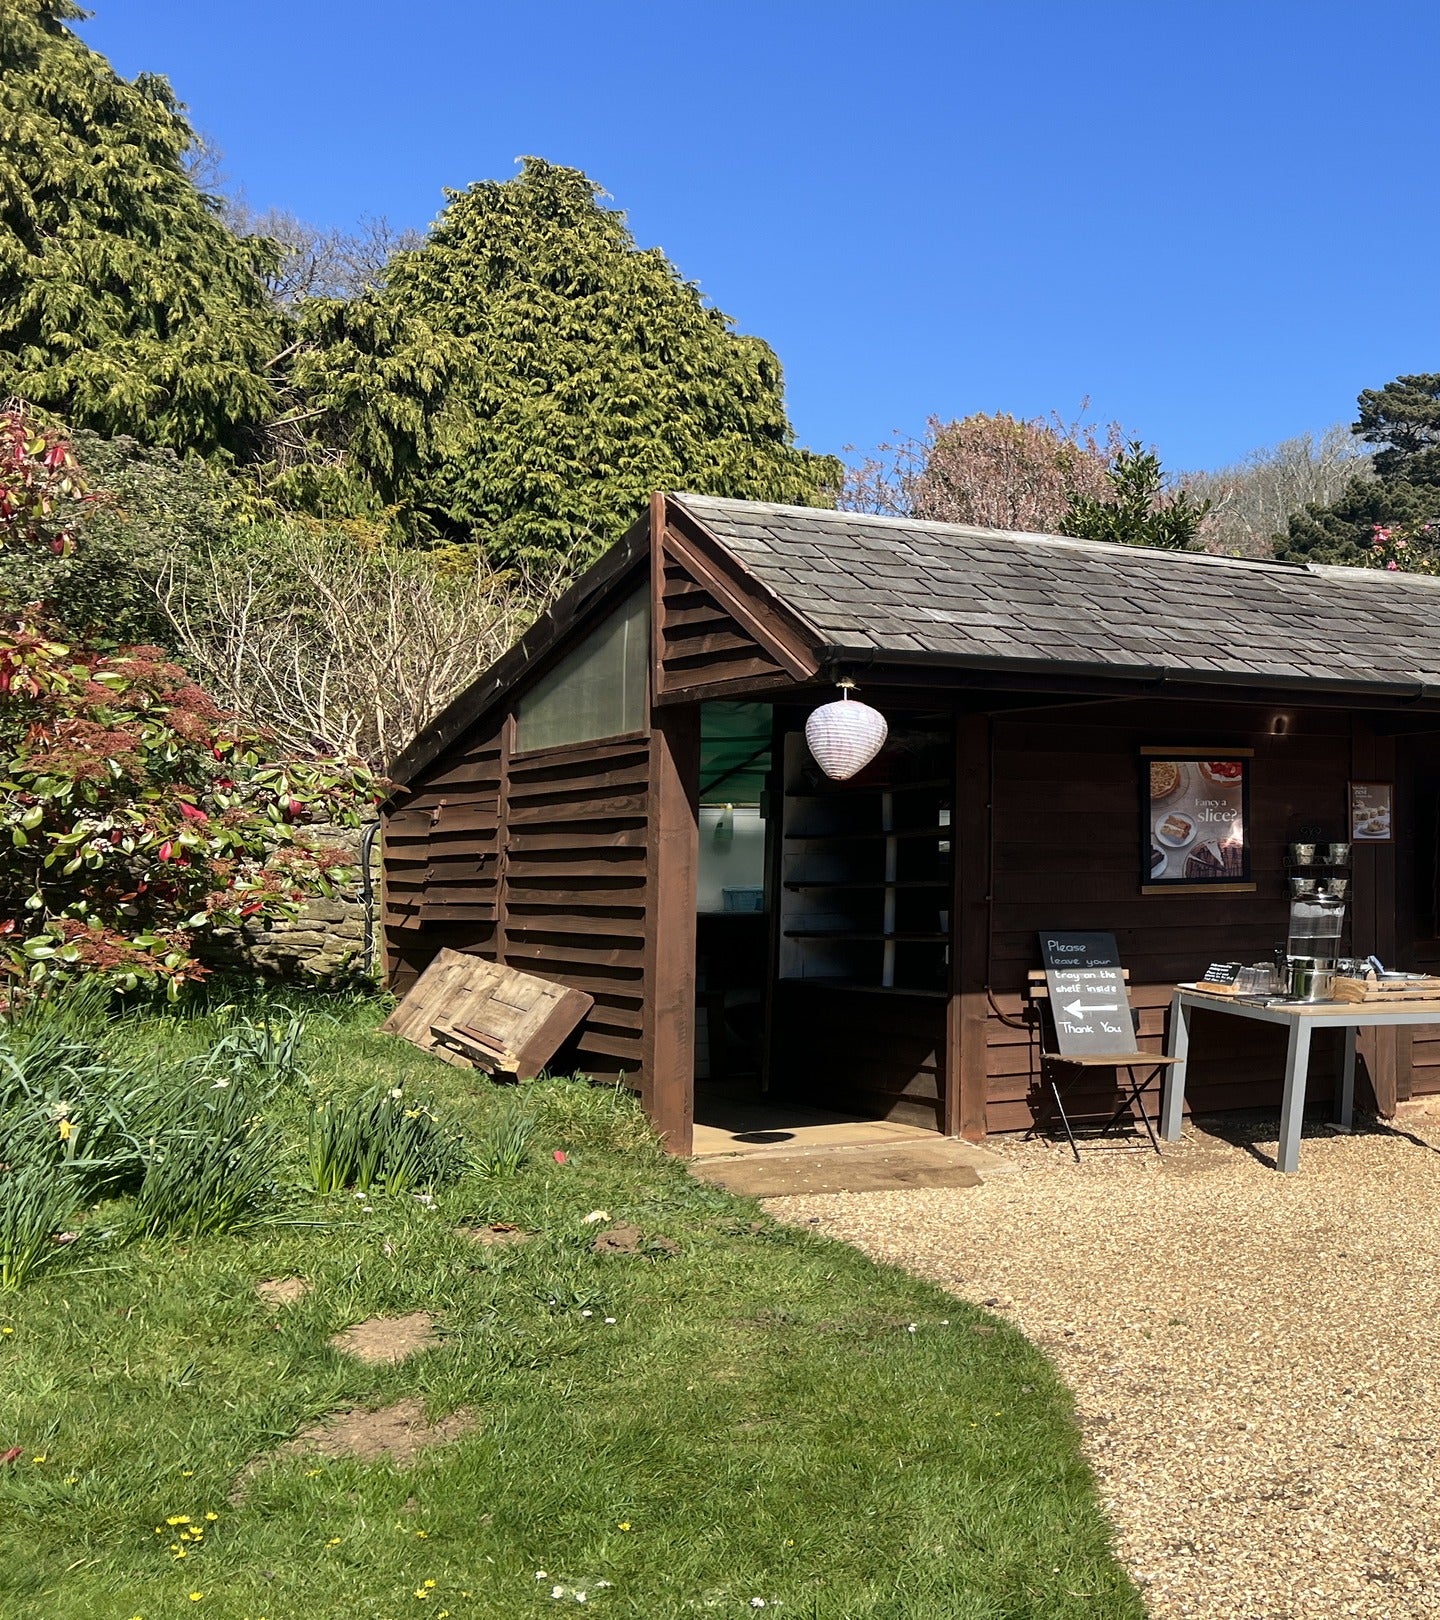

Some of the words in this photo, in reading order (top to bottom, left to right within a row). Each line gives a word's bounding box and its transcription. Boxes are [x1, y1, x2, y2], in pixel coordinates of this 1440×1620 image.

[1195, 798, 1220, 808] Fancy
[1198, 808, 1237, 822] slice?
[1047, 940, 1087, 952] Please
[1050, 955, 1080, 965] leave
[1086, 959, 1112, 967] your
[1054, 970, 1080, 982] tray
[1100, 970, 1117, 979] the
[1055, 984, 1082, 993] shelf
[1086, 984, 1117, 993] inside
[1058, 1021, 1095, 1034] Thank
[1100, 1021, 1122, 1033] You
